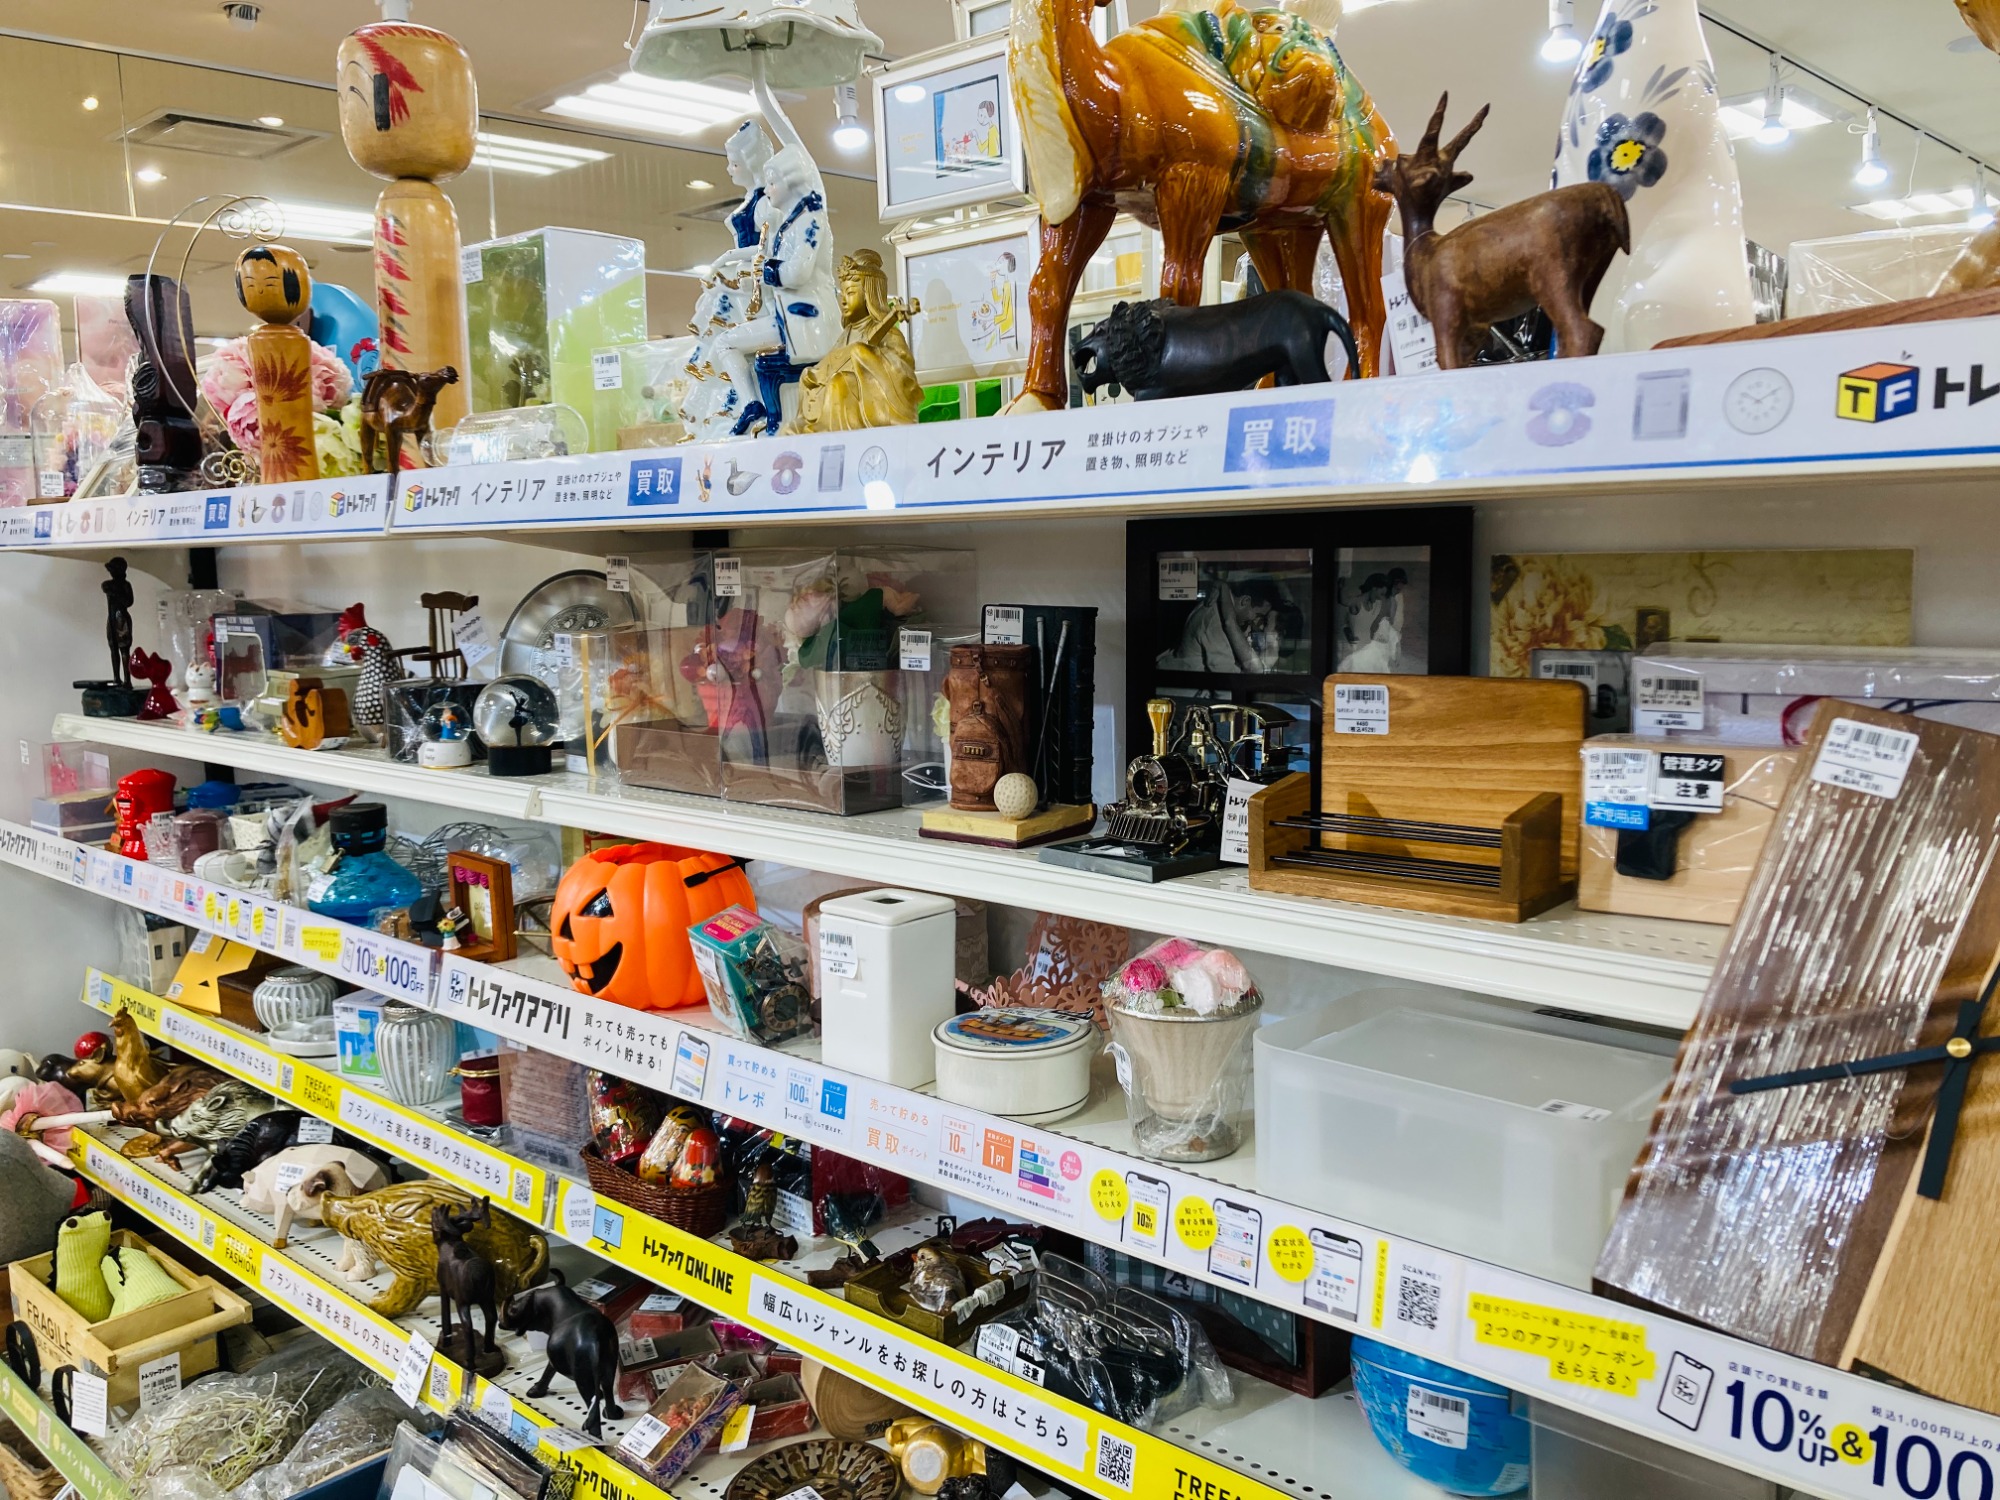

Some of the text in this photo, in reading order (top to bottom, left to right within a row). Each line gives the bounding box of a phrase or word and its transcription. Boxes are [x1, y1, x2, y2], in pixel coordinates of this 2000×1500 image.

[1843, 378, 1913, 415] TF
[1086, 424, 1210, 449] 壁掛けのオブジェや
[1241, 416, 1318, 458] 買取
[927, 437, 1067, 479] インテリア
[1085, 449, 1190, 472] 置き物、照明など
[471, 478, 546, 507] インテリア
[634, 467, 676, 497] 買取
[126, 509, 166, 527] インテリア
[207, 502, 228, 523] 買取
[1662, 755, 1724, 773] 管理タグ
[1676, 781, 1710, 800] 注意
[370, 965, 380, 979] UP
[409, 980, 425, 996] OFF
[136, 1002, 157, 1023] ONLINE
[467, 976, 571, 1041] トレファクアプリ
[584, 1011, 669, 1051] 買っても売っても
[165, 1016, 274, 1077] 幅広いジャンルをお探しの方はこちら
[727, 1053, 777, 1079] 買って貯める
[304, 1074, 333, 1096] TREFAC
[725, 1080, 766, 1108] トレポ
[302, 1088, 336, 1113] FASHION
[869, 1096, 929, 1127] 売って貯める
[347, 1100, 502, 1185] ブランド・古着をお探しの方はこちら
[866, 1126, 928, 1161] 買取ポイント
[948, 1132, 967, 1155] 10円
[90, 1153, 195, 1230] 幅広いジャンルをお探しの方はこちら
[1097, 1189, 1122, 1198] クーポン
[1100, 1179, 1114, 1188] 限定
[569, 1208, 592, 1217] ONLINE
[1098, 1200, 1122, 1209] もらえる
[1184, 1207, 1205, 1215] 知って
[570, 1219, 591, 1228] STORE
[1178, 1218, 1214, 1227] 得する情報
[1184, 1229, 1211, 1237] おとどけ
[1272, 1237, 1306, 1248] 査定状況
[1275, 1250, 1306, 1259] が一目で
[224, 1247, 257, 1277] FASHION
[642, 1235, 734, 1295] トレファク ONLINE
[1281, 1261, 1303, 1270] わかる
[1401, 1263, 1424, 1277] SCAN
[26, 1300, 73, 1356] FRAGILE
[1482, 1322, 1645, 1368] 2つのアプリクーポン
[762, 1290, 1071, 1449] 幅広いジャンルをお探しの方はこちら
[1022, 1362, 1040, 1382] 注意
[1727, 1361, 1830, 1401] 店頭での買取金額
[1797, 1438, 1840, 1467] UP
[1840, 1430, 1864, 1459] &
[1174, 1467, 1242, 1500] TREF
